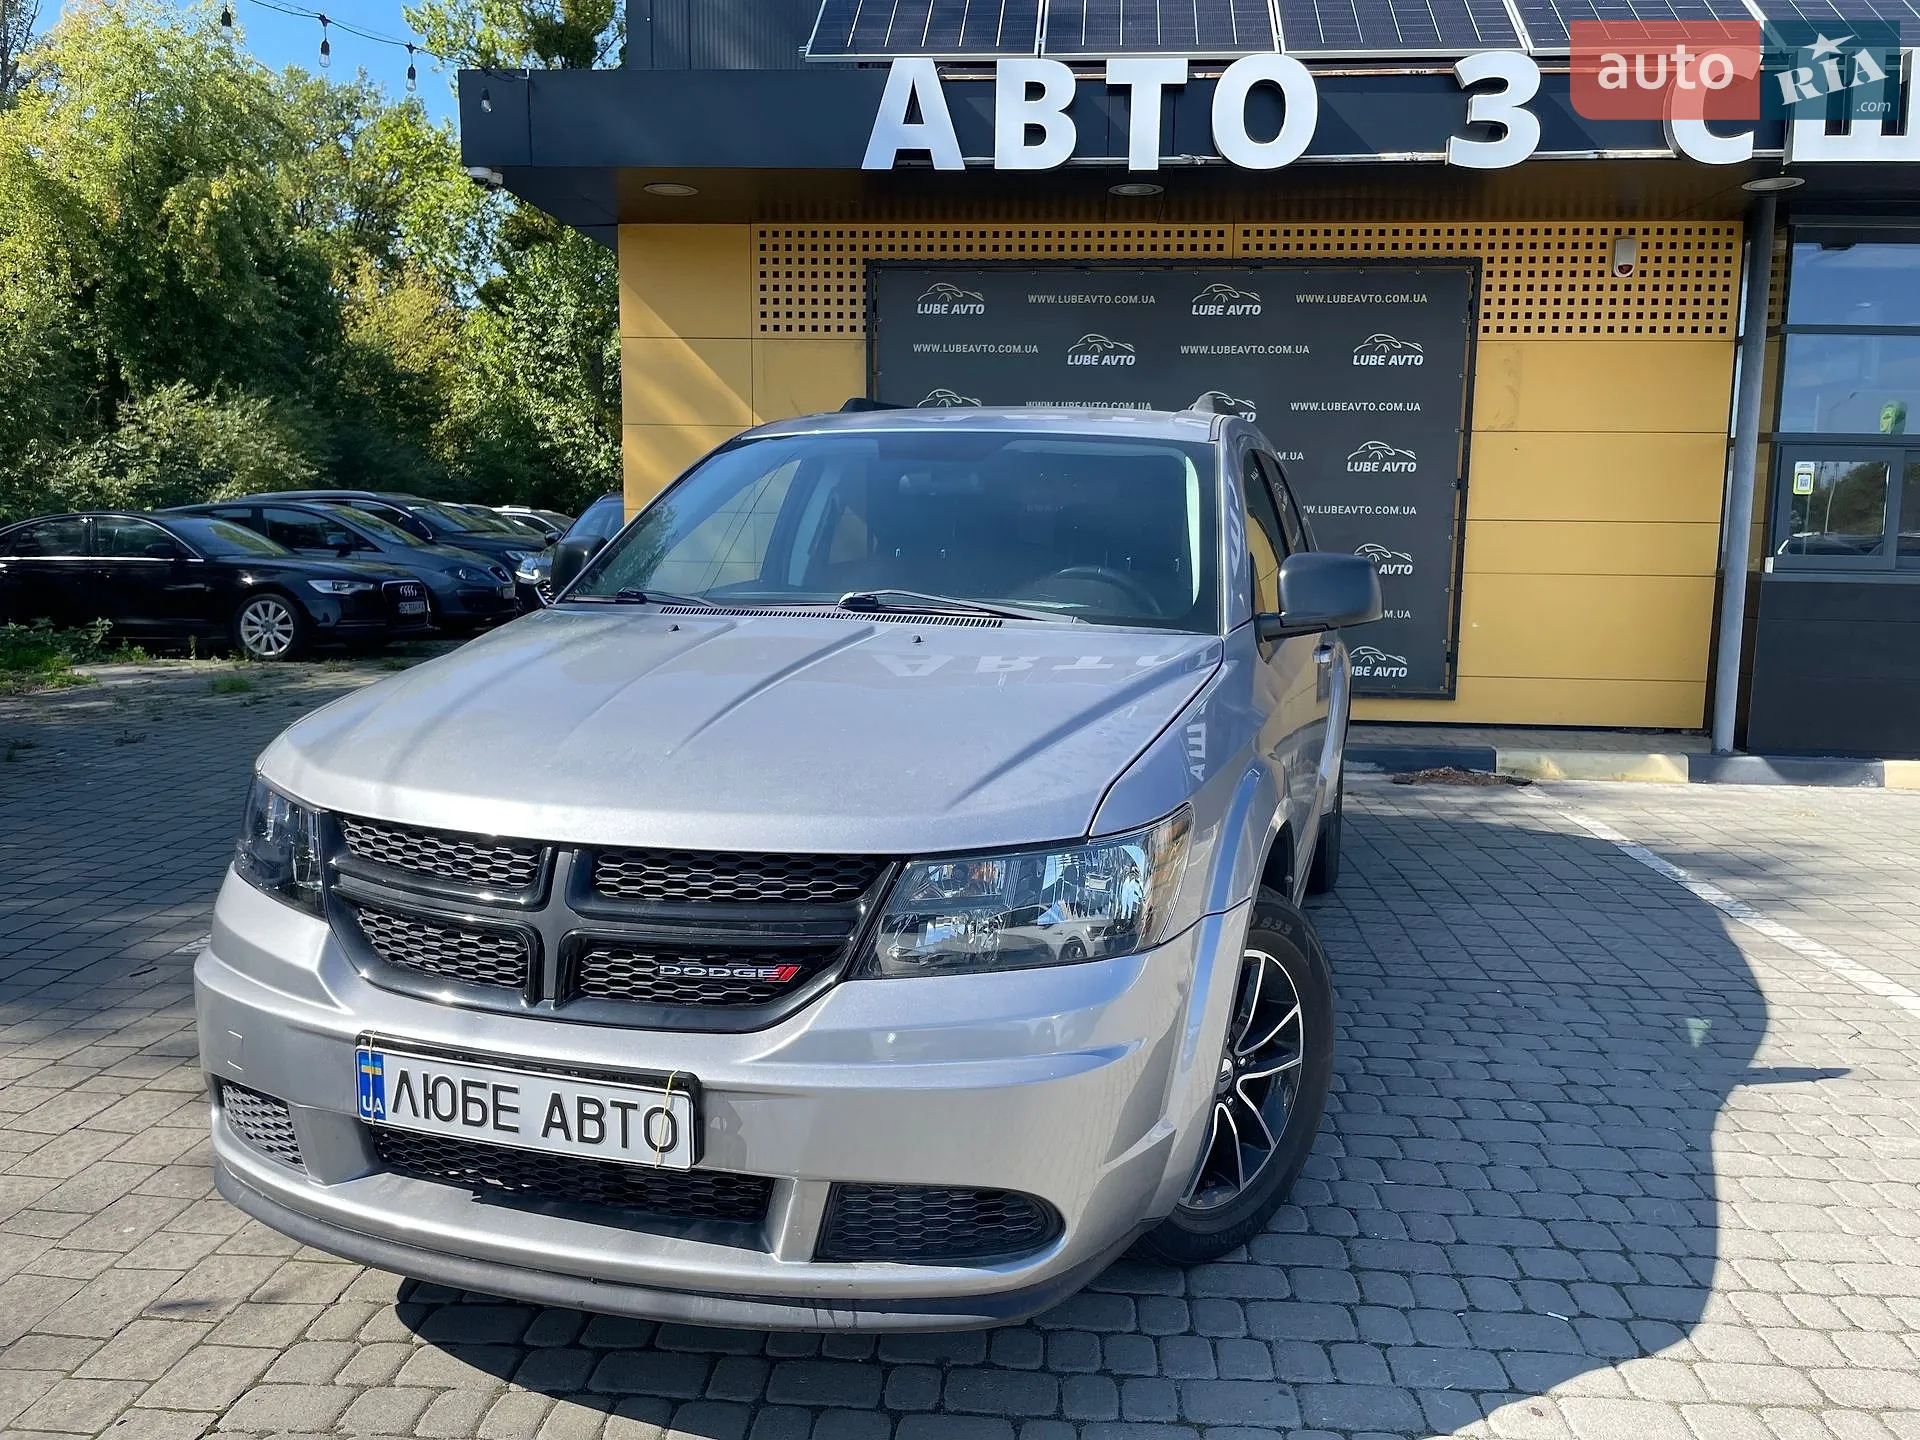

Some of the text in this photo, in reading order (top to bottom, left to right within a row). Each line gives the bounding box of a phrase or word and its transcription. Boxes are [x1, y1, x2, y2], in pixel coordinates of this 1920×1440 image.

[860, 53, 1319, 171] АВТО
[1027, 294, 1156, 305] WWW.LUBEAVTO.COM.UA
[1295, 293, 1428, 304] WWW.LUBEAVTO.COM.UA
[917, 303, 985, 316] LUBE AVTO
[1191, 304, 1262, 316] LUBE AVTO
[912, 343, 1039, 354] WWW.LUBEAVTO.COM.UA
[1180, 345, 1310, 355] WWW.LUBEAVTO.COM.UA
[1067, 354, 1136, 366] LUBE AVTO
[1352, 354, 1424, 366] LUBE AVTO
[1290, 402, 1421, 412] WWW.LUBEAVTO.COM.UA
[1346, 462, 1417, 473] LUBE AVTO
[1303, 505, 1417, 515] W.LUBEAVTO.COM.UA
[1378, 564, 1413, 575] AVTO
[1373, 666, 1408, 678] AVTO
[659, 965, 780, 978] DODGE
[361, 1094, 385, 1115] UA
[391, 1068, 678, 1154] ЛЮБЕ АВТО
